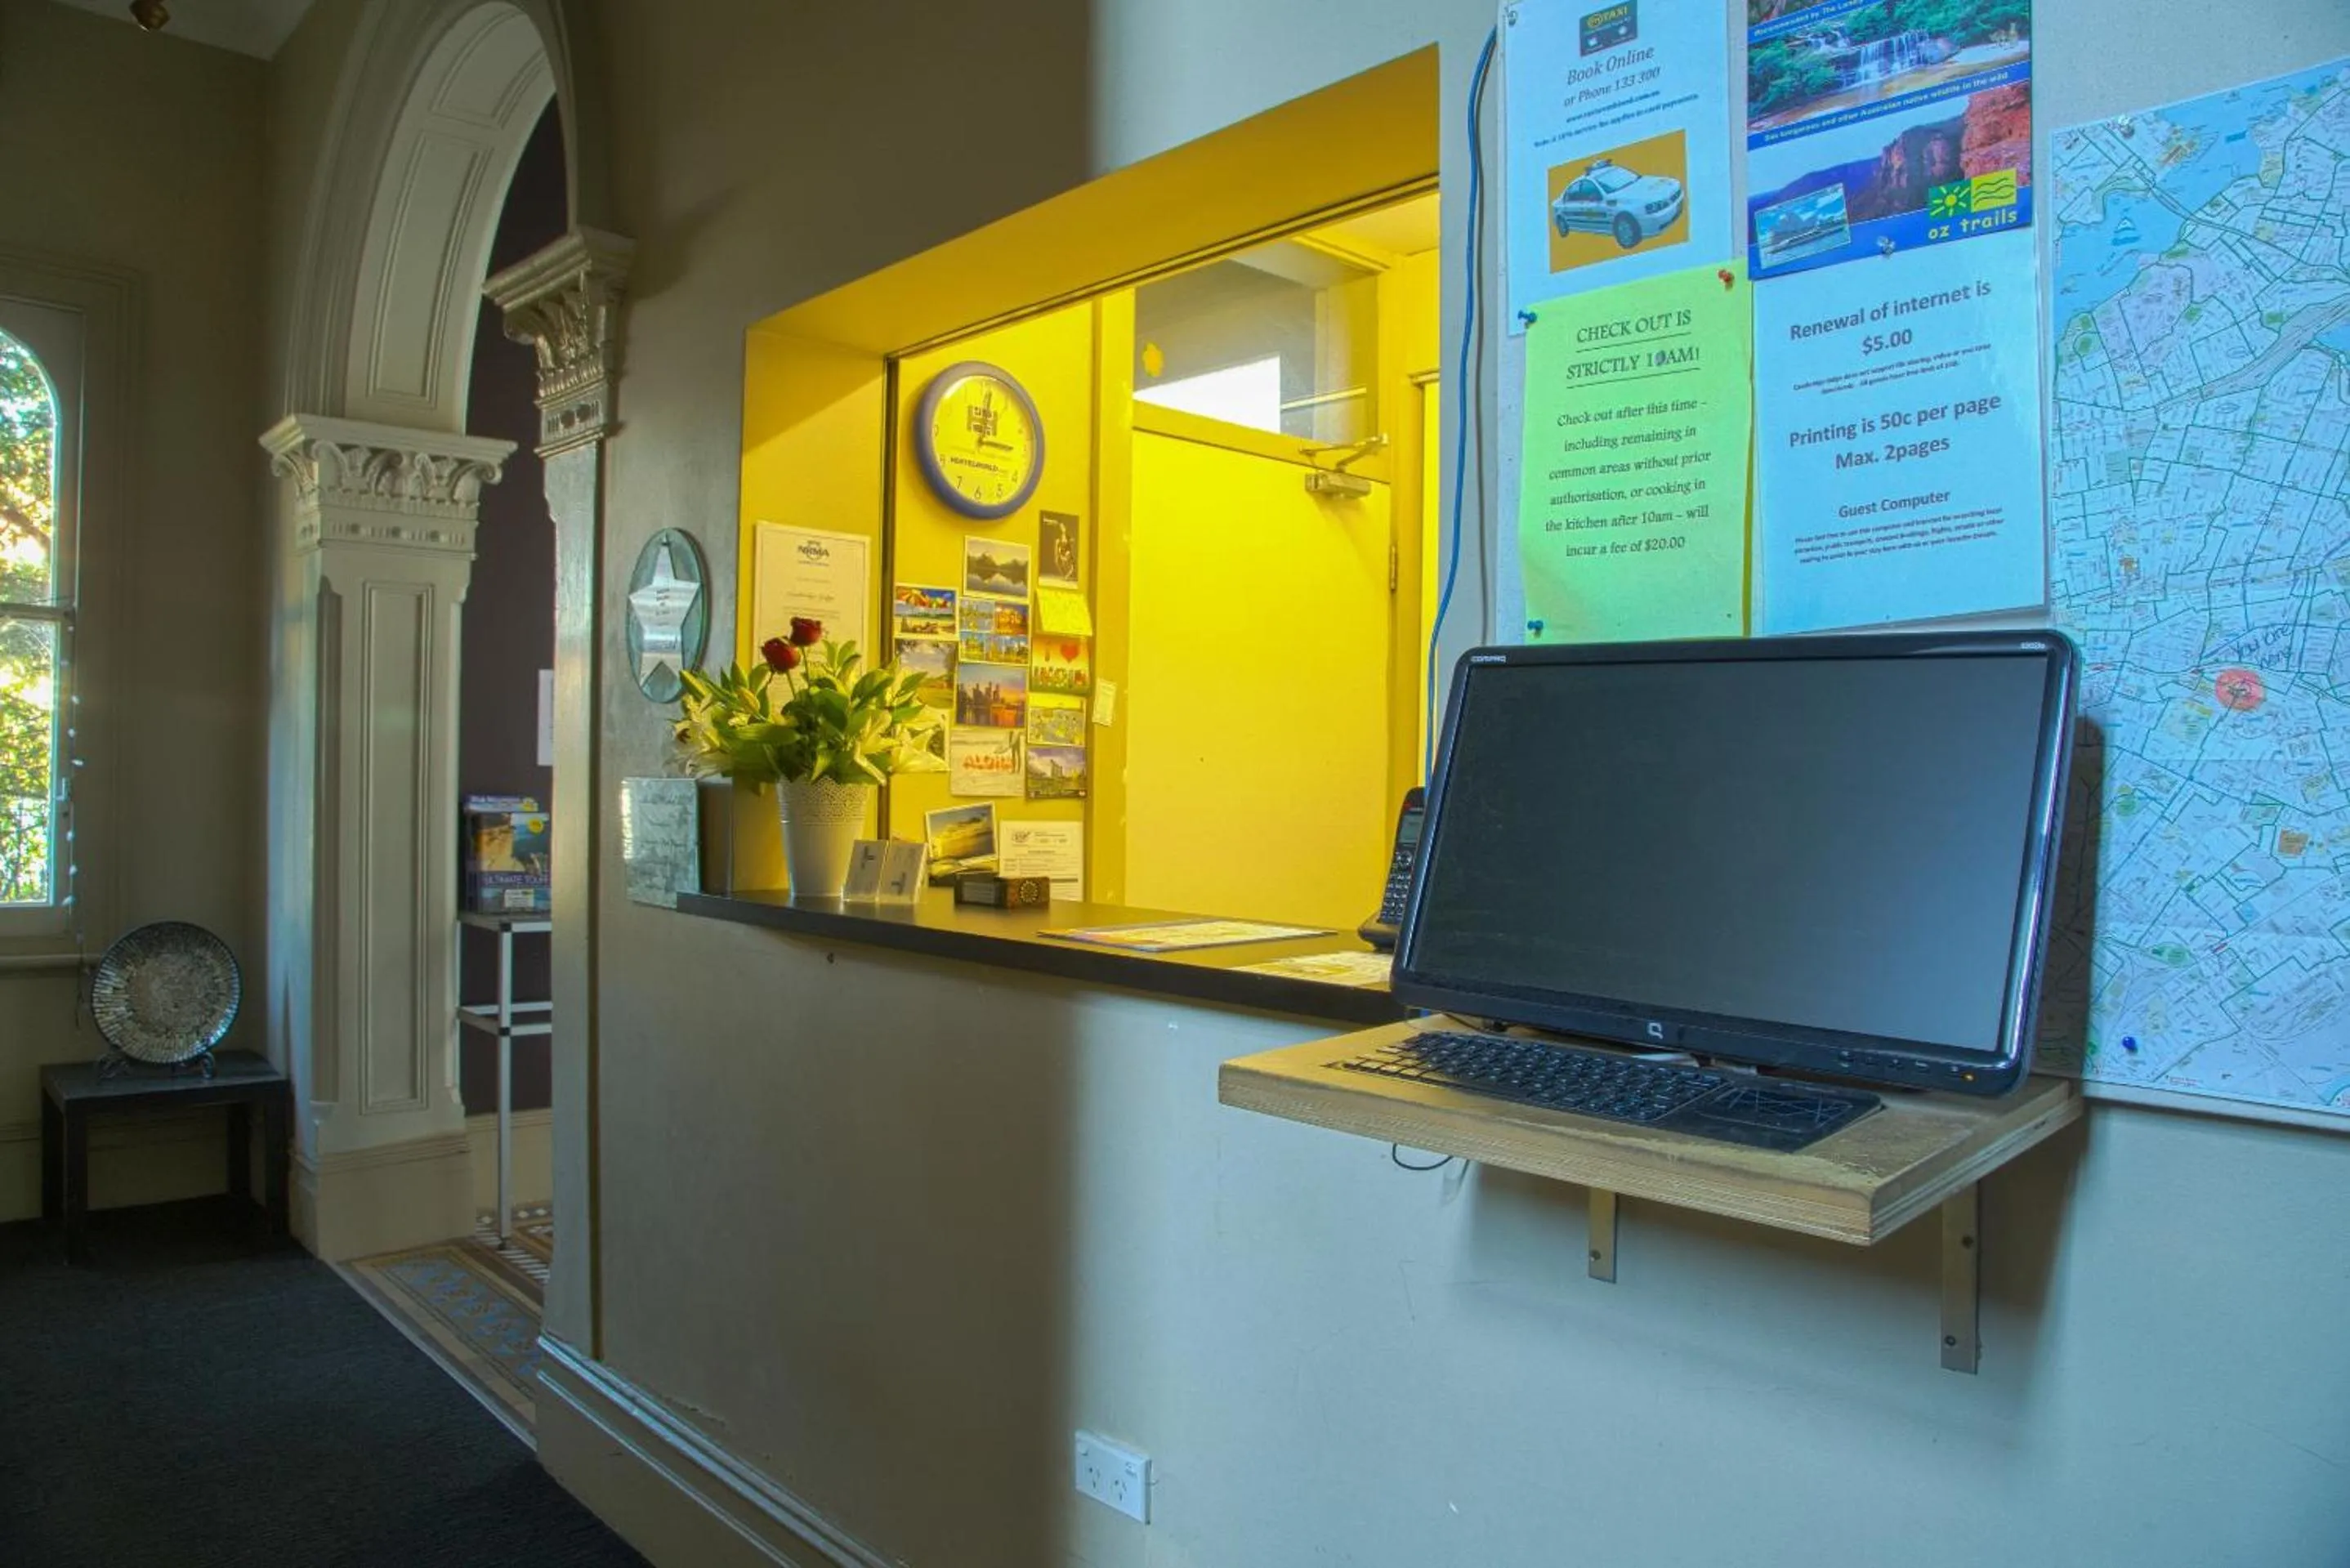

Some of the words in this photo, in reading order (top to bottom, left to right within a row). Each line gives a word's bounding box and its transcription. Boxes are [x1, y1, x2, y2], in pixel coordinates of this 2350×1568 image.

[1822, 6, 1837, 16] The
[1566, 60, 1604, 85] Book
[1605, 46, 1655, 71] Online
[1972, 78, 1988, 88] the
[1989, 71, 2009, 85] wild
[1563, 97, 1576, 108] or
[1577, 82, 1612, 105] Phone
[1614, 74, 1636, 92] 133
[1637, 66, 1661, 85] 300
[1928, 223, 1950, 240] oz
[1959, 210, 2018, 234] trails
[1789, 309, 1865, 341] Renewal
[1869, 302, 1889, 322] of
[1892, 285, 1971, 315] internet
[1975, 279, 1992, 297] is
[1575, 319, 1632, 343] CHECK
[1634, 312, 1673, 335] OUT
[1676, 309, 1691, 327] IS
[1861, 328, 1913, 355] $5.00
[1566, 355, 1639, 381] STRICTLY
[1557, 407, 1592, 427] Check
[1593, 405, 1614, 422] out
[1615, 402, 1644, 420] after
[1646, 398, 1669, 415] this
[1670, 395, 1699, 413] time
[1789, 419, 1858, 449] Printing
[1861, 417, 1875, 435] is
[1879, 410, 1911, 431] 50c
[1916, 405, 1949, 428] per
[1953, 395, 2003, 418] page
[1563, 431, 1619, 453] including
[1620, 427, 1682, 449] remaining
[1684, 425, 1696, 439] in
[1834, 449, 1880, 470] Max.
[1883, 436, 1950, 466] 2pages
[1548, 462, 1597, 480] common
[1598, 458, 1631, 474] areas
[1633, 453, 1679, 471] without
[1680, 450, 1712, 469] prior
[1549, 488, 1628, 507] authorisation,
[1629, 488, 1644, 498] or
[1645, 480, 1693, 499] cooking
[1694, 479, 1706, 491] in
[1838, 500, 1879, 519] Guest
[1880, 490, 1951, 515] Computer
[1544, 517, 1564, 533] the
[1565, 514, 1609, 533] kitchen
[1611, 512, 1638, 529] after
[1641, 510, 1673, 527] 10am
[1686, 505, 1709, 520] will
[1566, 543, 1597, 557] incur
[1599, 545, 1607, 555] a
[1610, 539, 1628, 554] fee
[1629, 538, 1643, 553] of
[1643, 535, 1686, 553] $20.00
[2229, 639, 2260, 658] You
